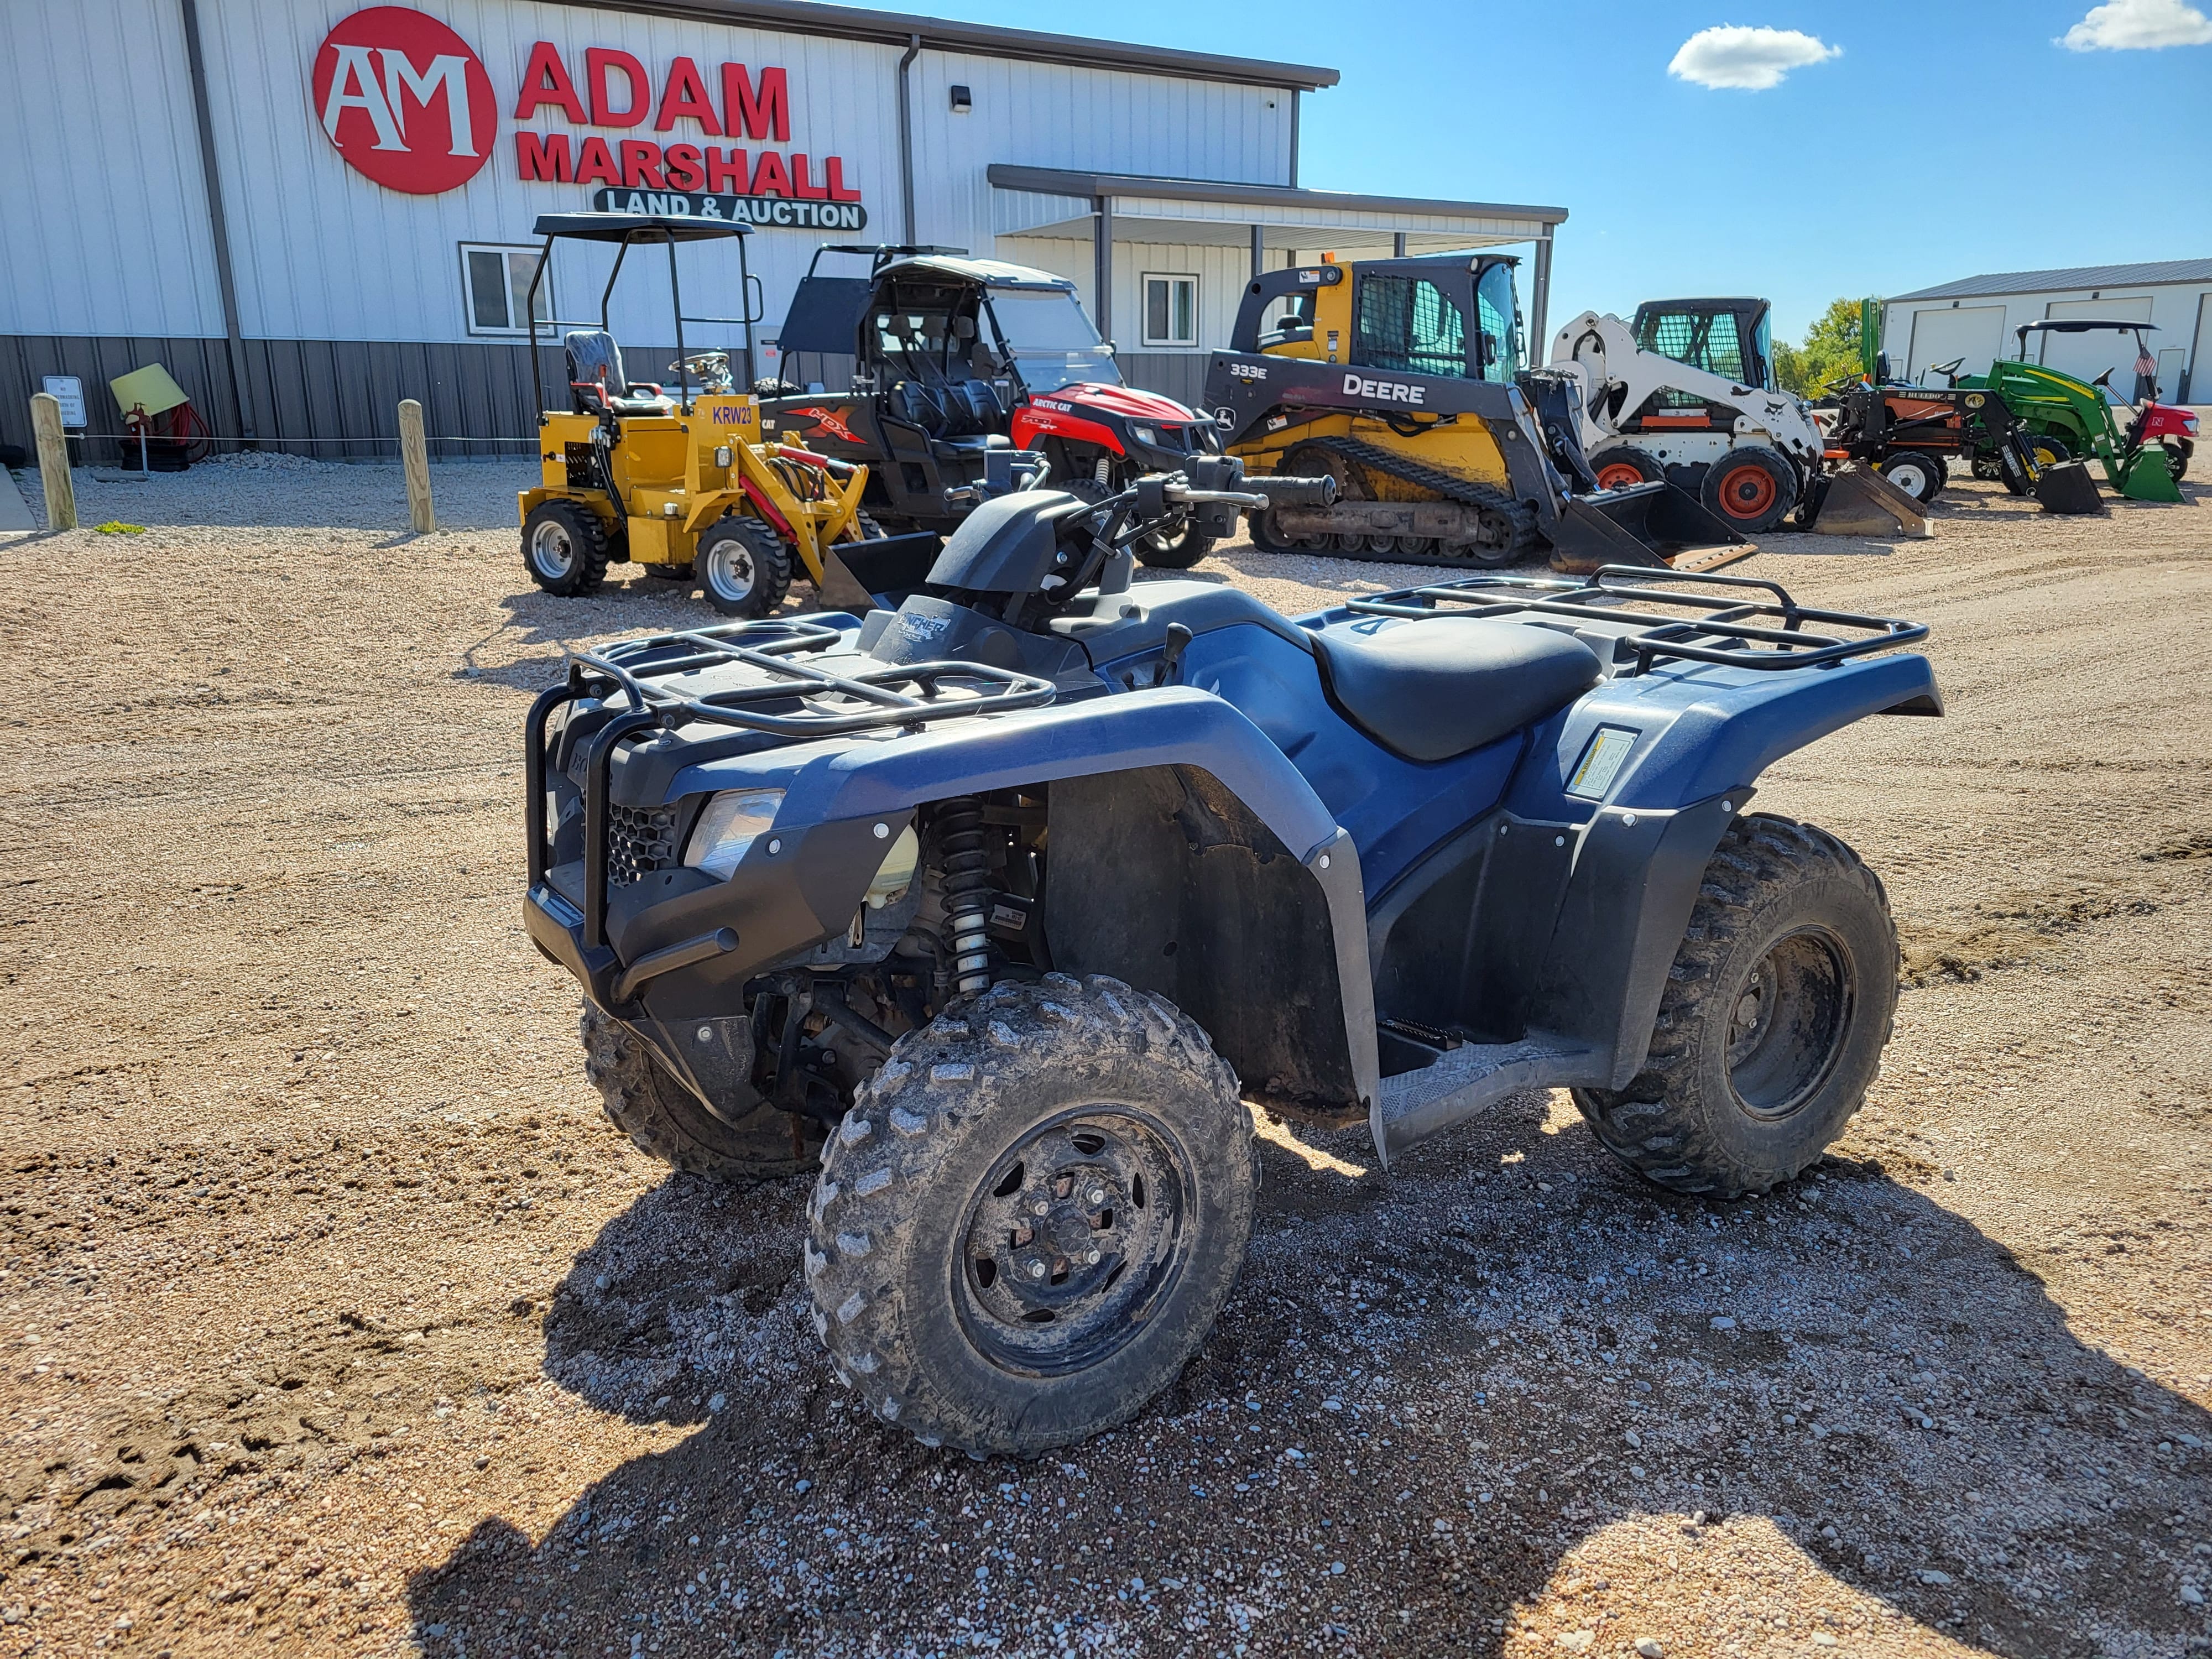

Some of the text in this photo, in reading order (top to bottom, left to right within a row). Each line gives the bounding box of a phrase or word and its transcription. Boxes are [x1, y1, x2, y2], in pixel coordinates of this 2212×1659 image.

[322, 43, 480, 157] AM
[514, 40, 791, 143] ADAM
[515, 131, 862, 202] MARSHALL
[608, 191, 860, 228] LAND & AUCTION
[1230, 363, 1268, 380] 333E
[1342, 373, 1426, 405] DEERE
[712, 406, 752, 425] KRW23
[1032, 398, 1073, 412] ARCTIC CAT
[761, 419, 775, 429] CAT
[808, 407, 853, 441] HDX
[1021, 415, 1051, 426] 700
[2151, 416, 2164, 426] N
[1584, 748, 1598, 770] WARNING
